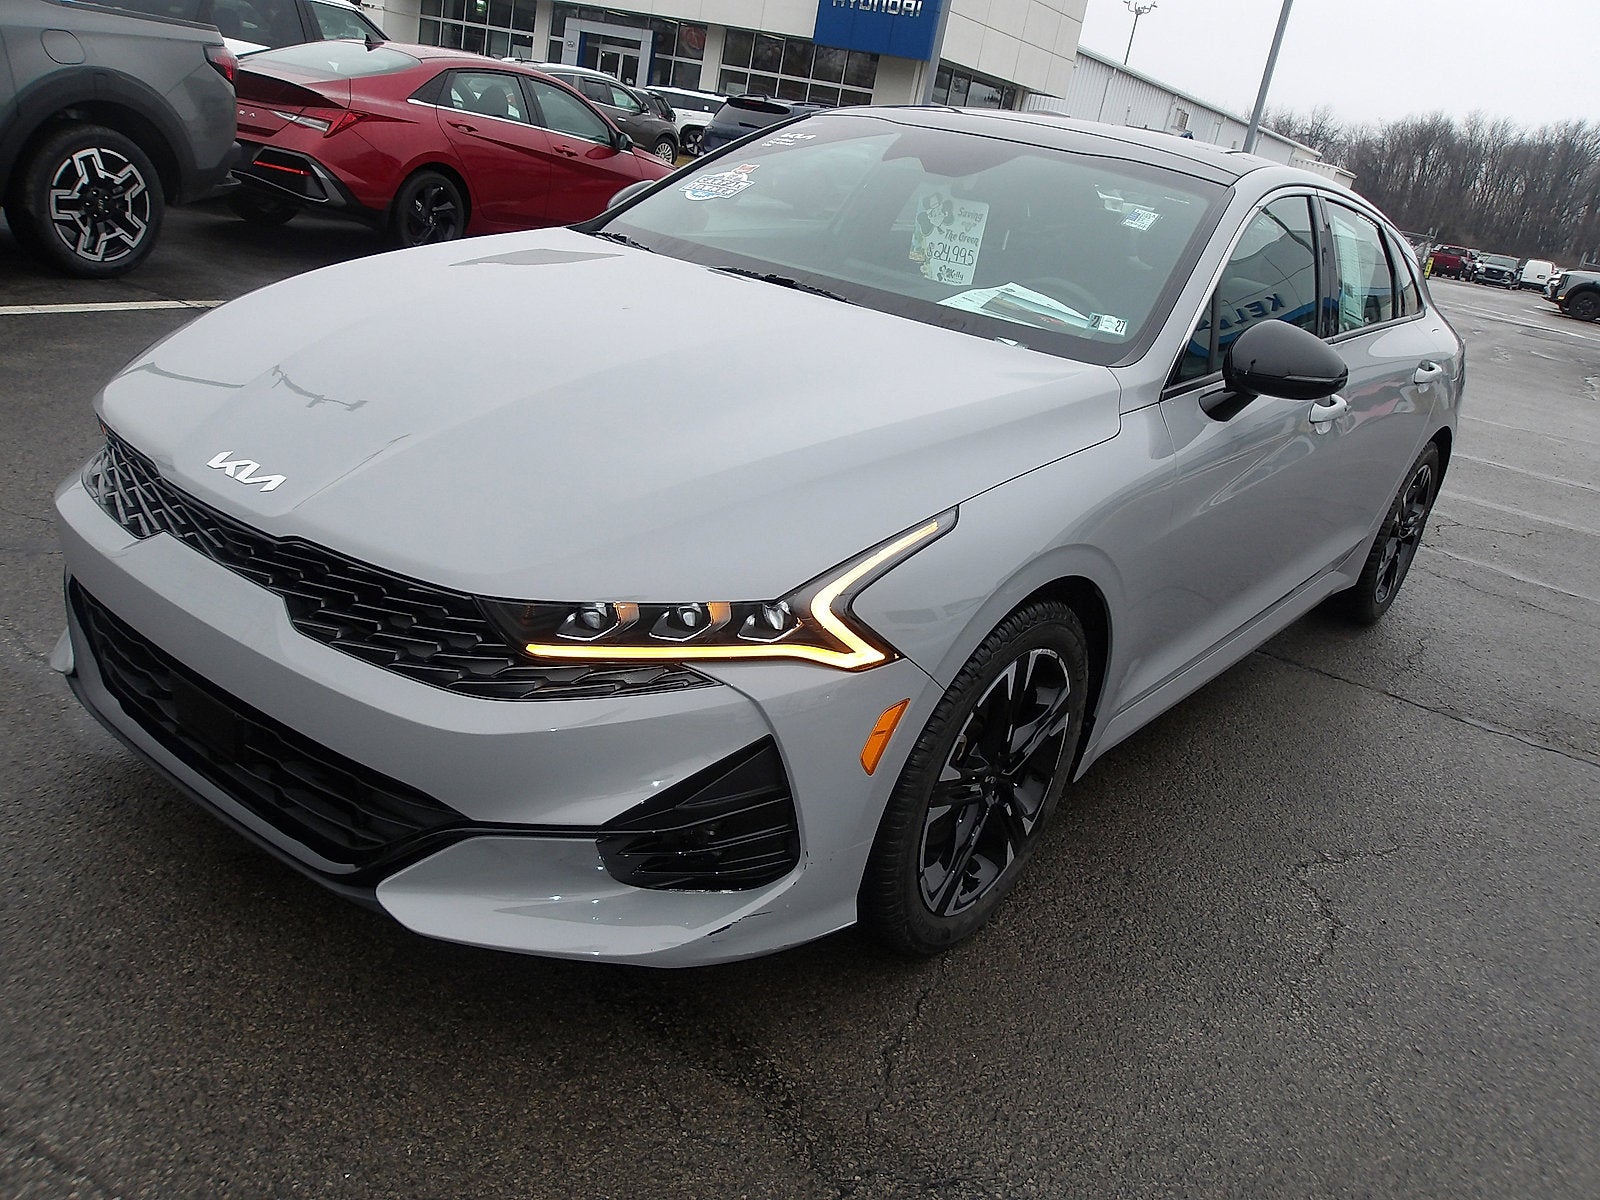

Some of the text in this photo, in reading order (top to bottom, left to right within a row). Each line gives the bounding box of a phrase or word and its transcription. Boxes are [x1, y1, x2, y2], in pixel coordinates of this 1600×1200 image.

[944, 229, 980, 247] The Green
[926, 241, 974, 266] $24,995
[1114, 319, 1126, 333] 27
[205, 449, 287, 493] KIA
